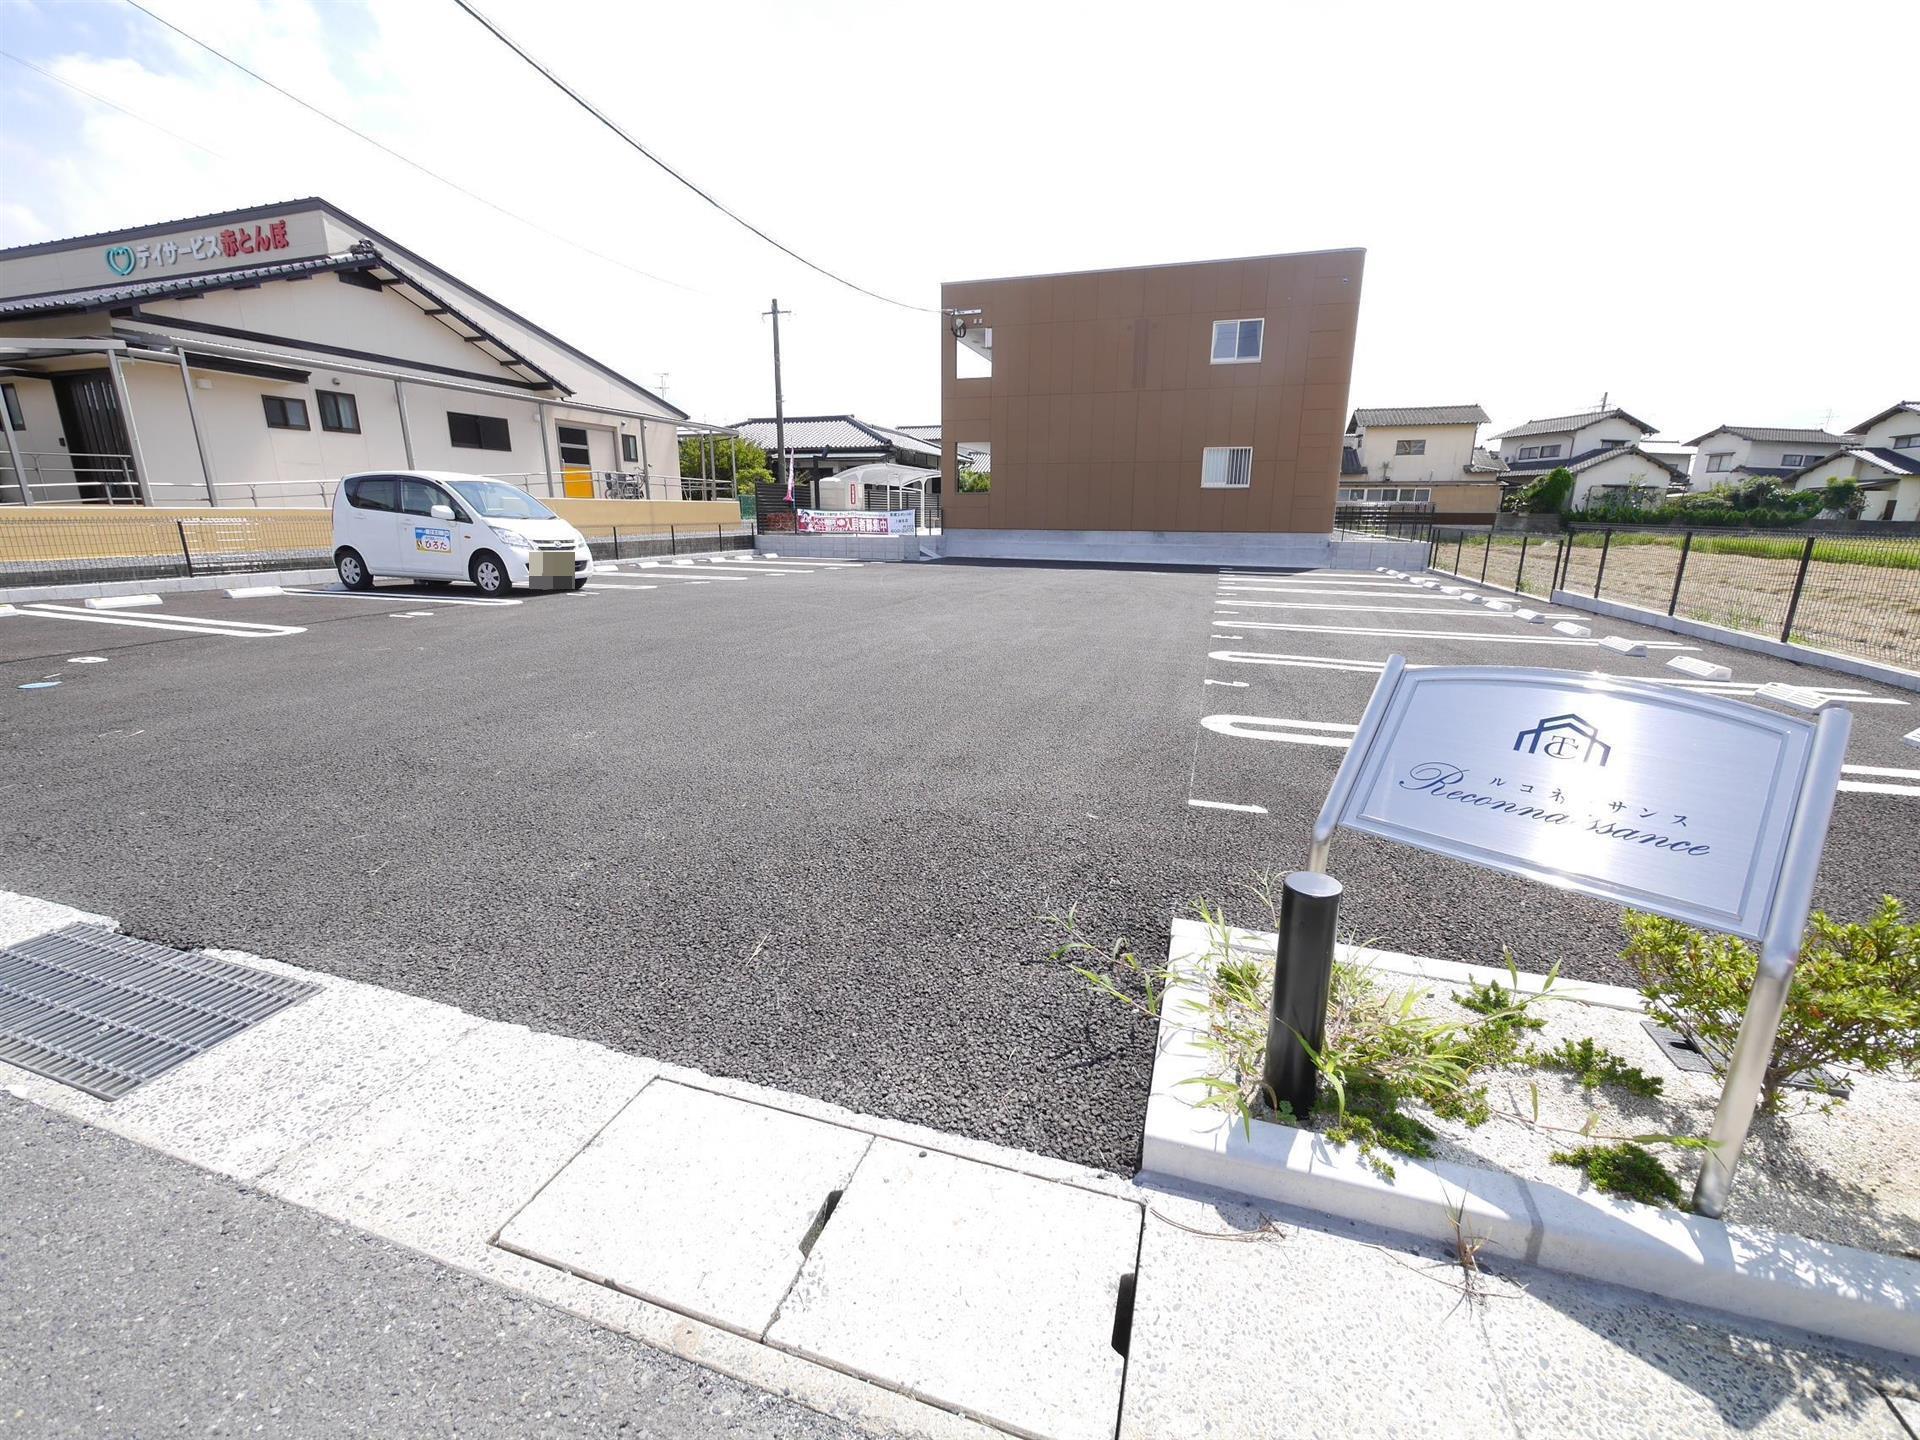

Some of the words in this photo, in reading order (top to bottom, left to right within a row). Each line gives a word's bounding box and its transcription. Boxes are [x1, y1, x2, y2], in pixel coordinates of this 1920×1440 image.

[1399, 761, 1711, 857] Reconnassance
[1489, 776, 1689, 828] ルコネサンス
